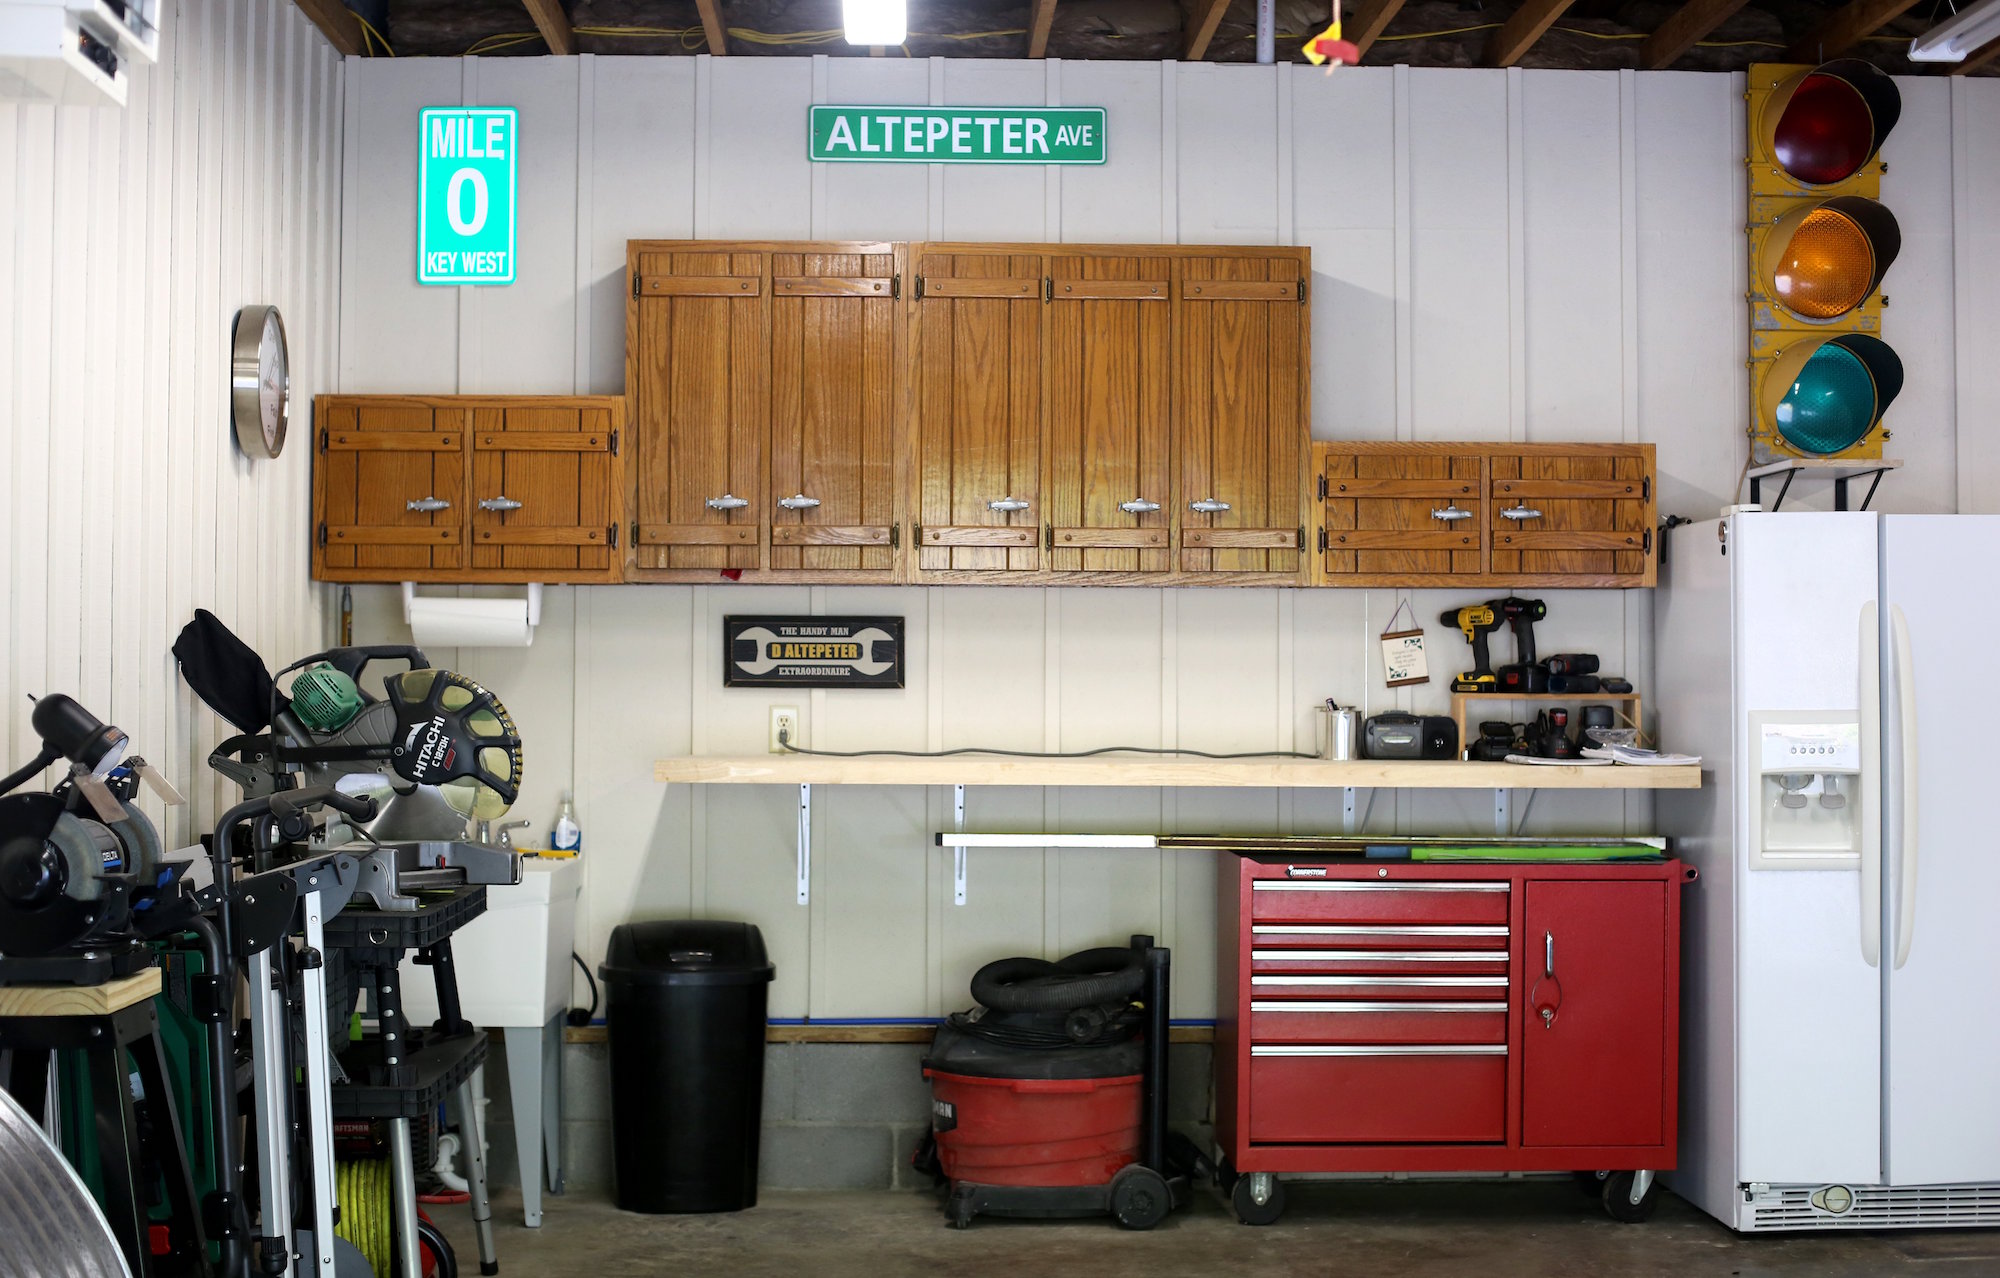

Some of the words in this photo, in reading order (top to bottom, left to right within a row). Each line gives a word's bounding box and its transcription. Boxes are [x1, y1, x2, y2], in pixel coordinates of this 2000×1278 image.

[431, 117, 505, 160] MILE
[824, 115, 1050, 154] ALTEPETER
[1054, 125, 1093, 147] AVE
[446, 167, 489, 236] 0
[427, 251, 457, 274] KEY
[461, 251, 506, 274] WEST
[780, 626, 798, 636] THE
[800, 626, 828, 636] HANDY
[830, 627, 849, 636] MAN
[771, 643, 782, 658] D
[784, 643, 858, 658] ALTEPETER
[778, 667, 851, 676] EXTRAORDINAIRE
[412, 715, 446, 778] HITACHI
[335, 1124, 369, 1132] AFTSMAN
